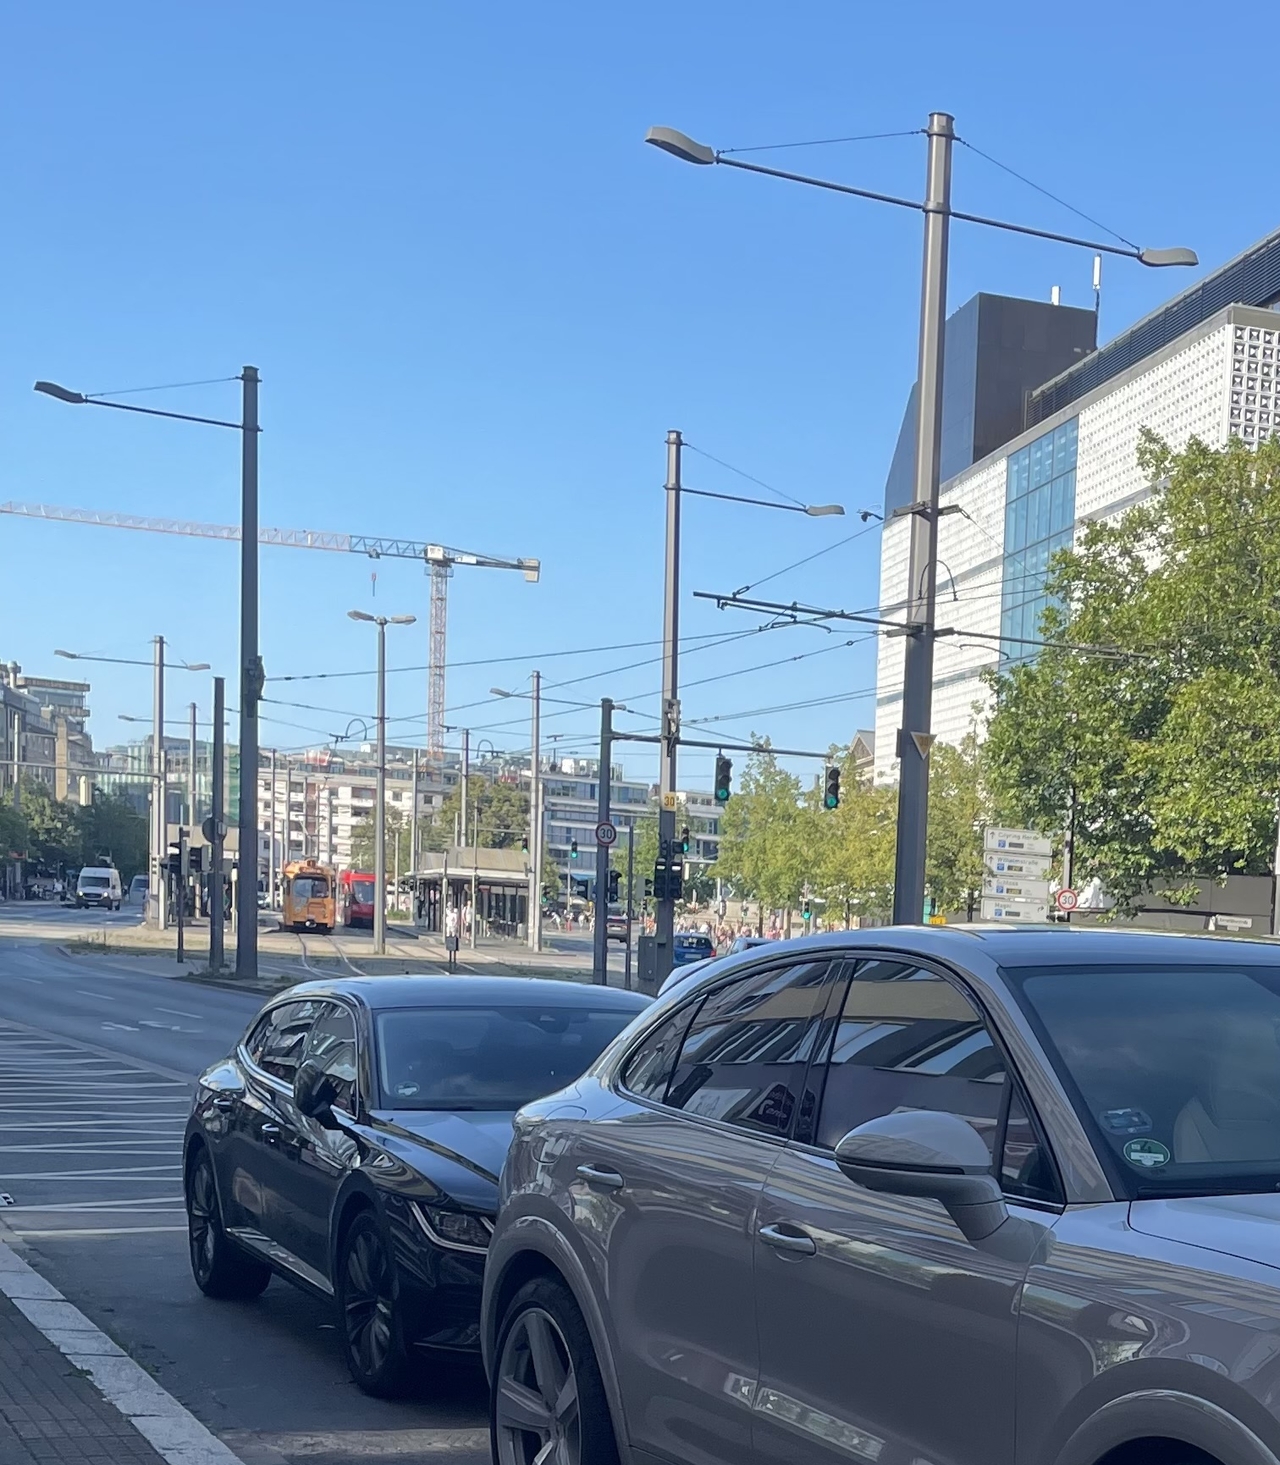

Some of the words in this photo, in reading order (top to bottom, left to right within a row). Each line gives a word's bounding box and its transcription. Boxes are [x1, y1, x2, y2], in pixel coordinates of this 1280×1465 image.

[664, 796, 675, 807] 30
[600, 828, 612, 839] 30
[1061, 895, 1073, 905] 30
